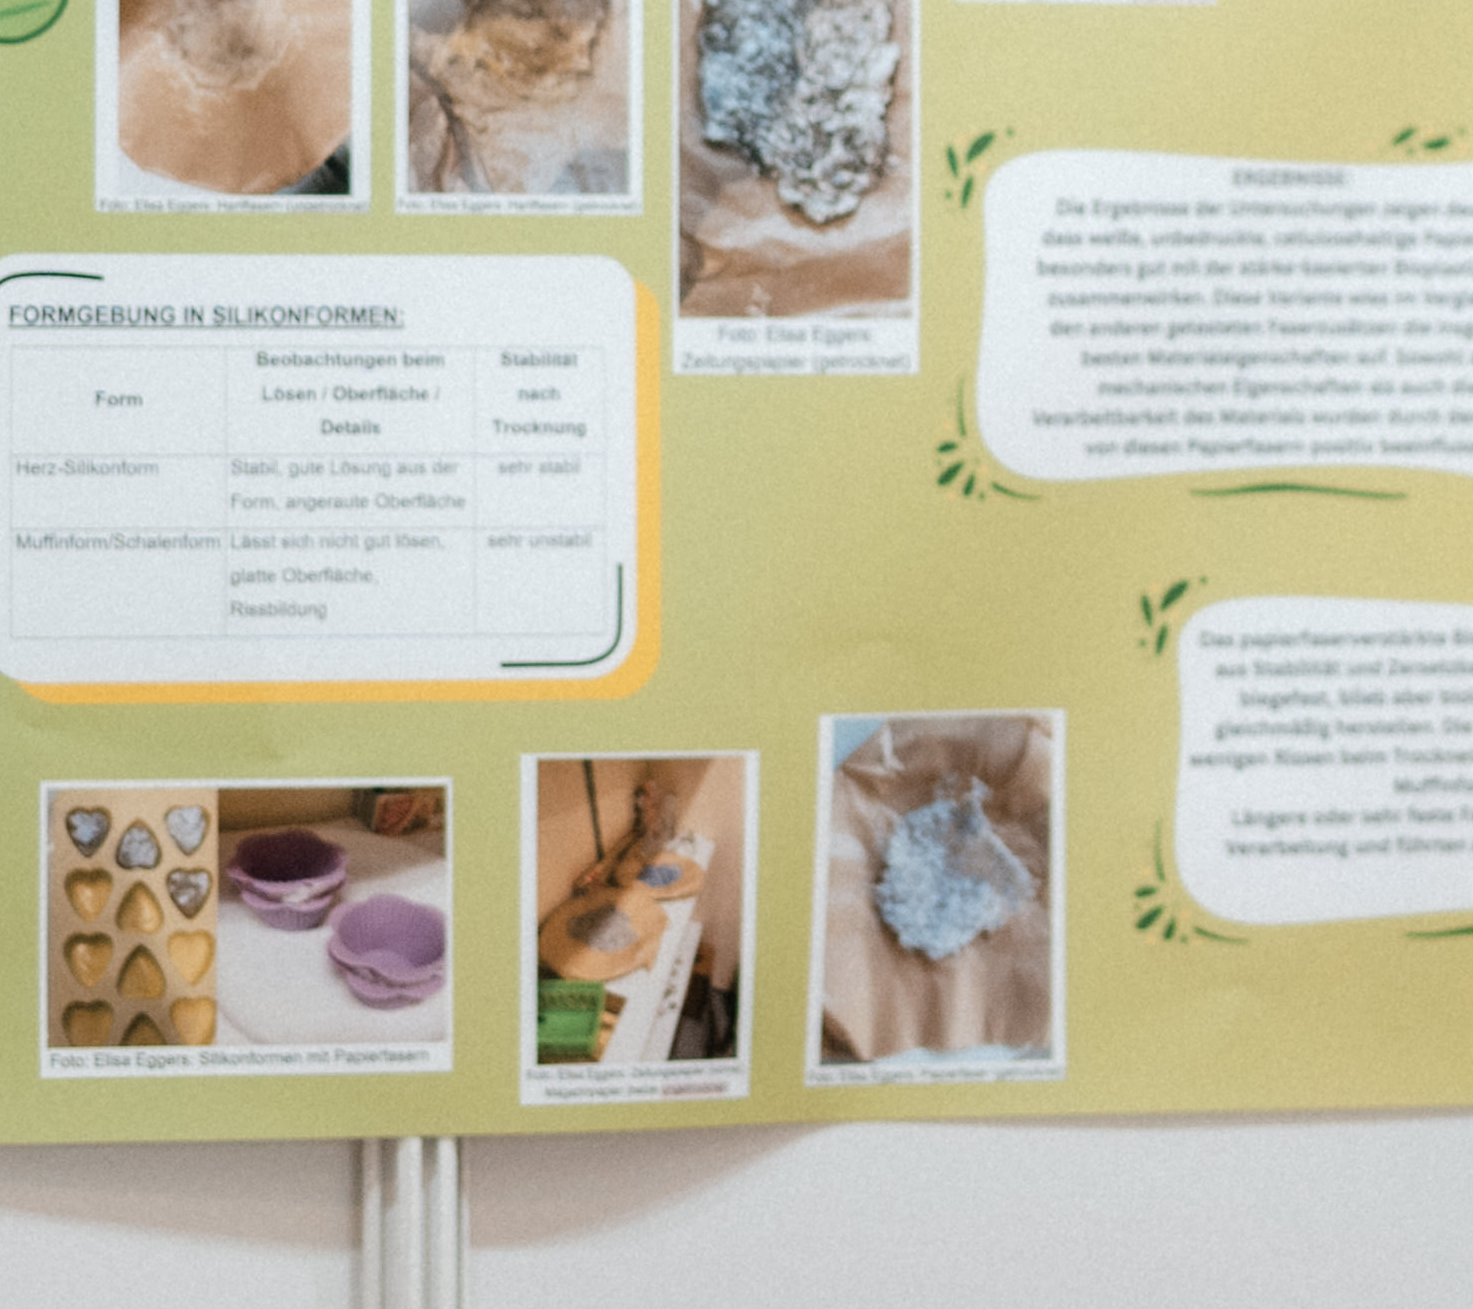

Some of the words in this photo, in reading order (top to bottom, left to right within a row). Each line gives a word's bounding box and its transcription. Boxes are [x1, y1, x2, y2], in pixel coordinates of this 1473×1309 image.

[10, 305, 176, 325] FORMGEBUNG
[183, 307, 204, 325] IN
[212, 306, 403, 326] SILIKONFORMEN:
